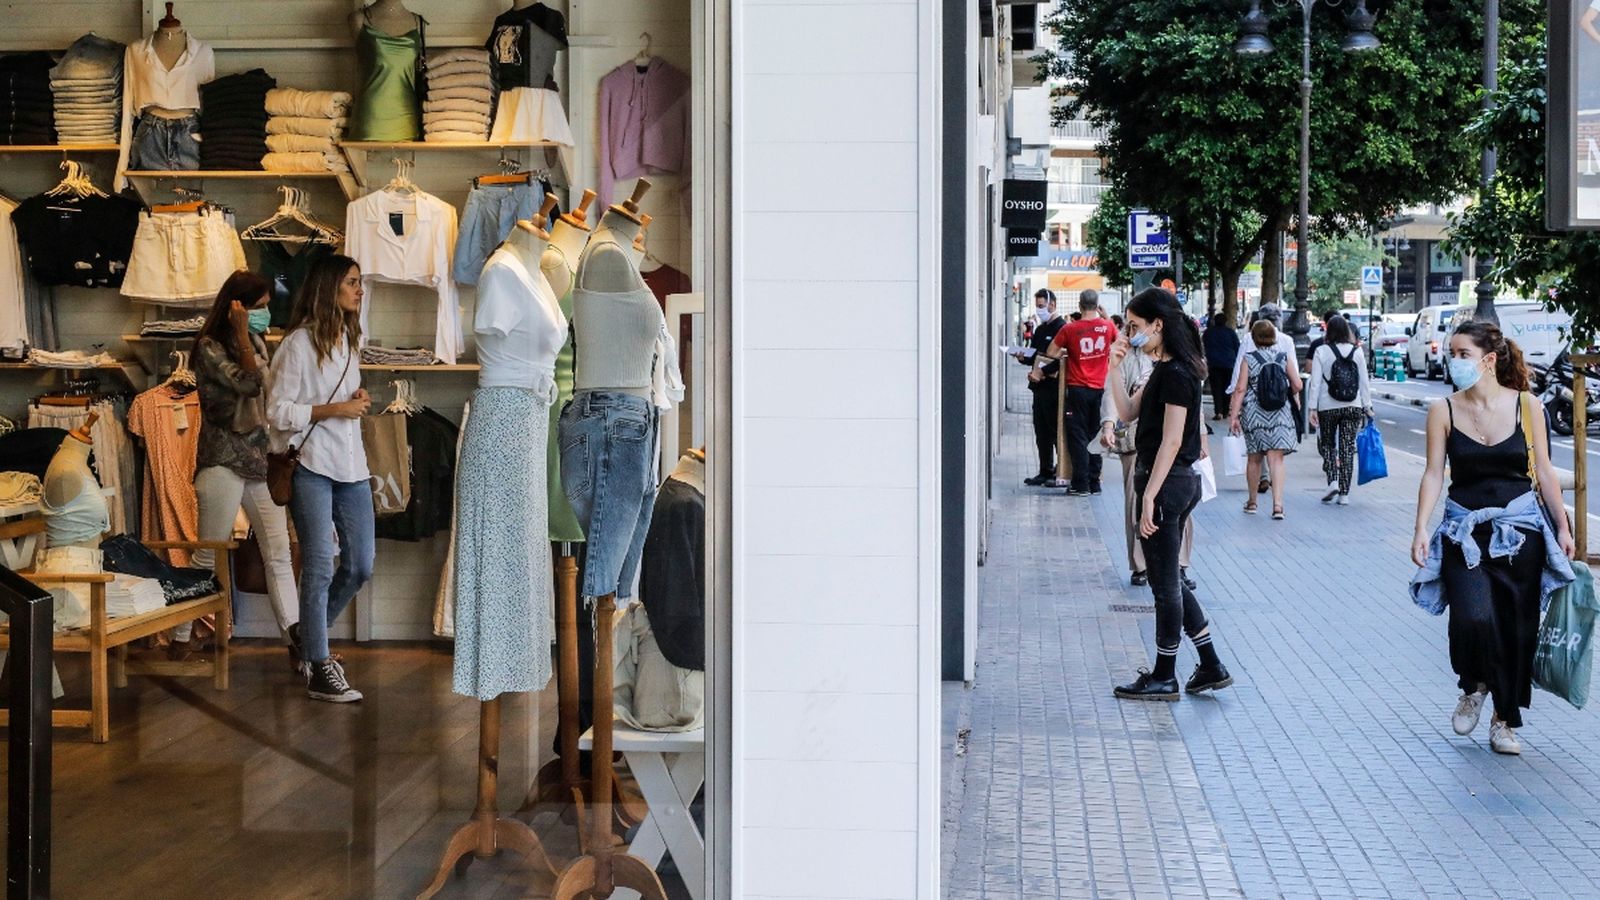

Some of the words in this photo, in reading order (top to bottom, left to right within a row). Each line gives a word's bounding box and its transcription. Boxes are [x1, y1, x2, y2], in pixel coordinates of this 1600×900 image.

[1004, 199, 1044, 211] OYSHO
[1135, 214, 1164, 244] P
[1009, 236, 1038, 245] OYSHO
[1080, 336, 1106, 354] 04
